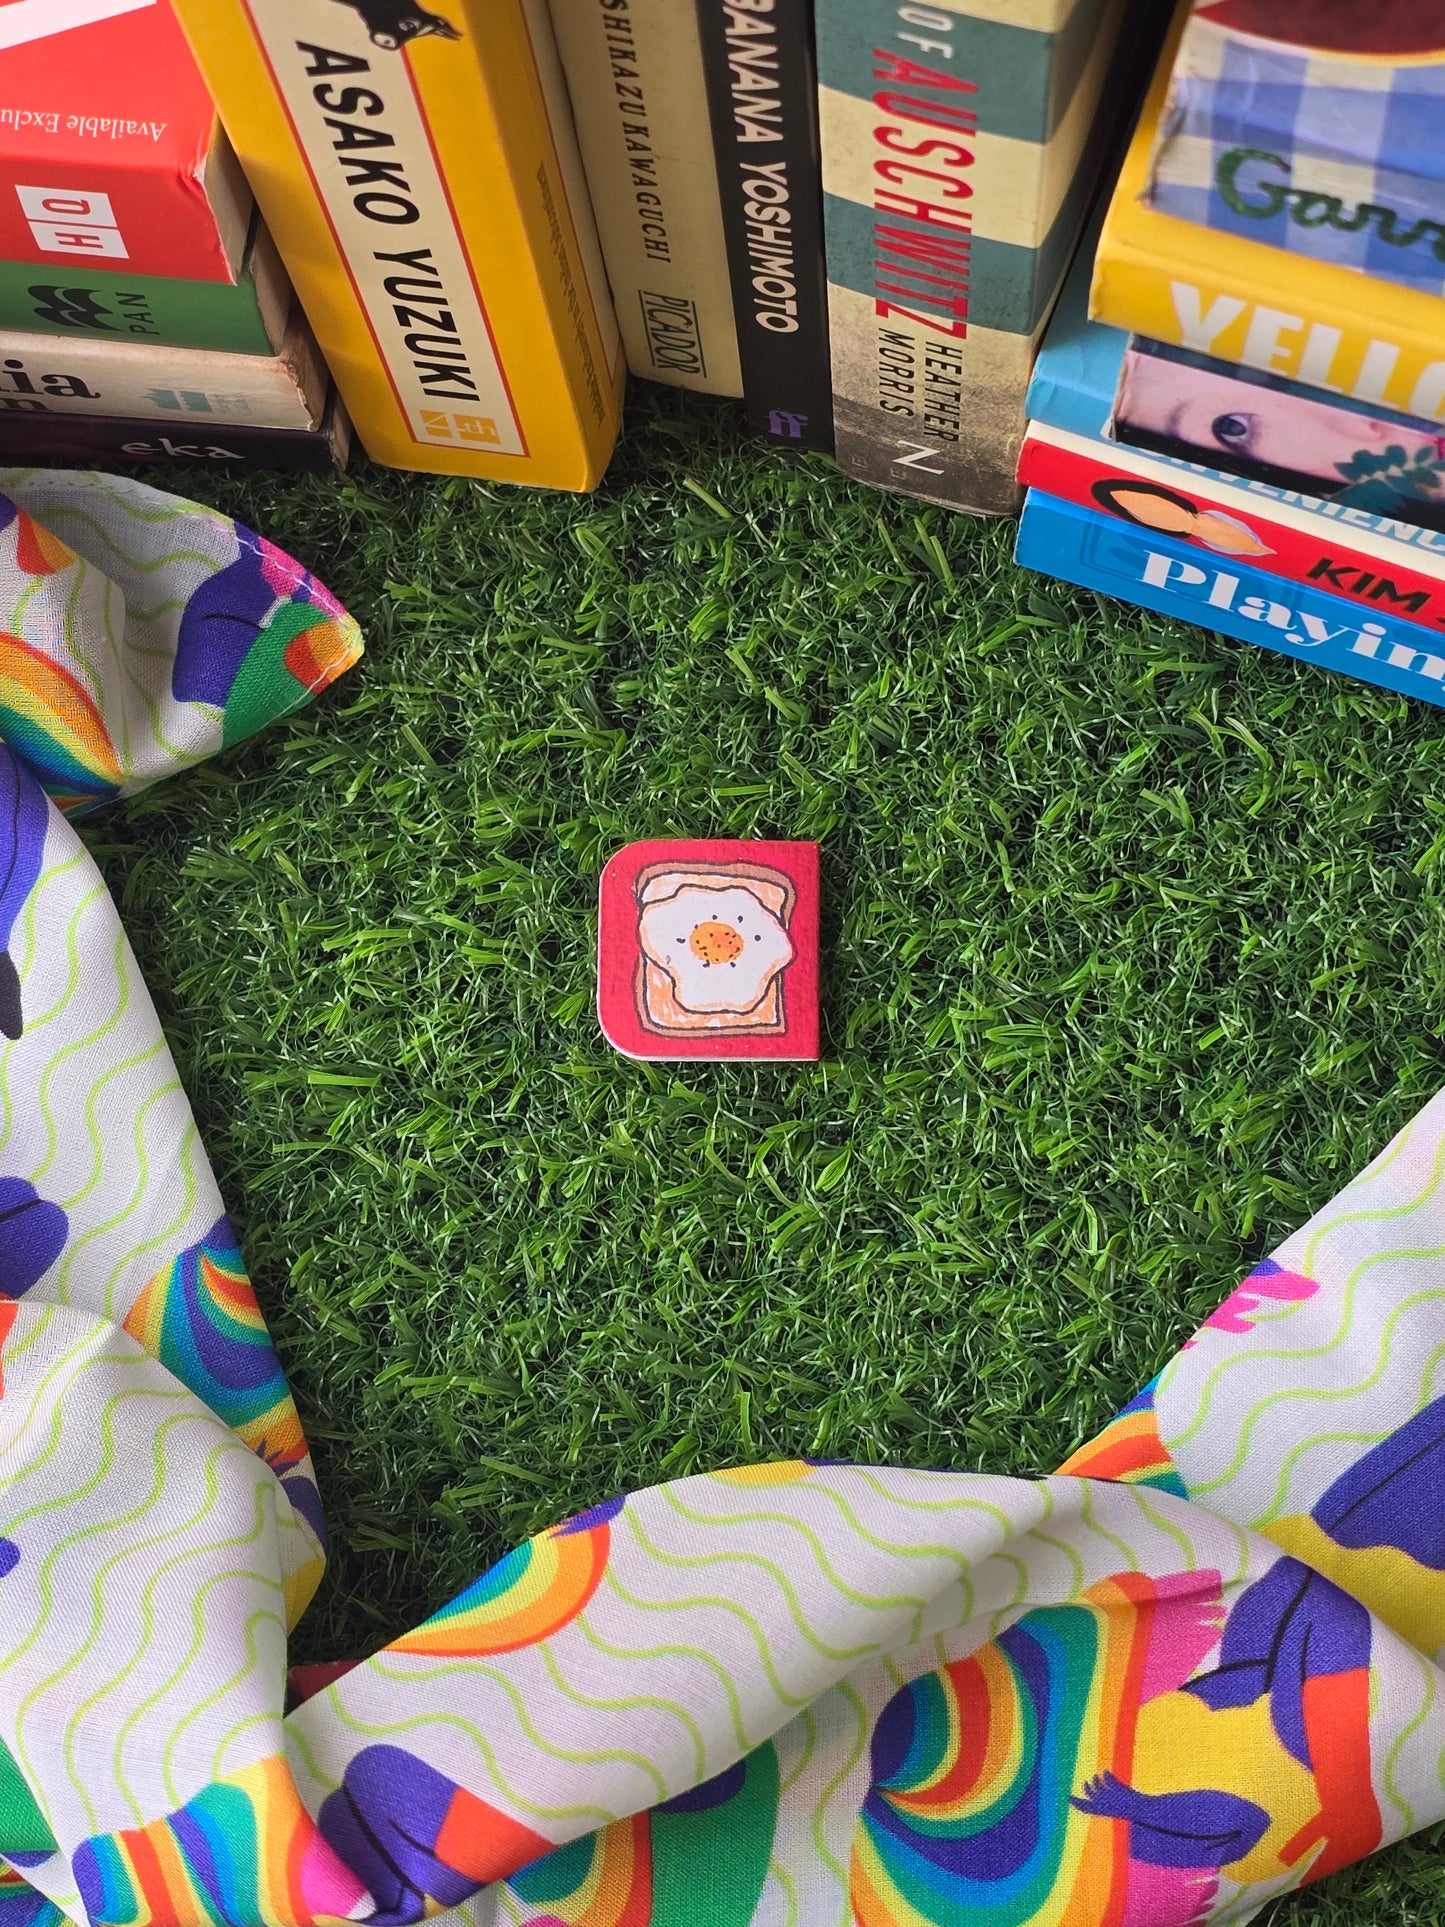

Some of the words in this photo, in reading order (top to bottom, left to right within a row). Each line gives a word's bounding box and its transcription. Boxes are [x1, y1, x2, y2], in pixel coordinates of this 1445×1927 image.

[897, 6, 954, 59] OF
[0, 109, 61, 134] Exclu
[66, 115, 168, 142] Available
[295, 40, 420, 225] ASAKO
[373, 248, 480, 402] YUZUKI
[622, 121, 672, 263] KAWAGUCHI
[872, 48, 980, 340] AUSCHWITZ
[739, 162, 799, 334] YOSHIMOTO
[115, 291, 160, 336] PAN
[643, 290, 701, 375] PICADOR
[0, 359, 101, 399] ia
[878, 327, 916, 418] MORRIS
[924, 341, 963, 442] HEATHER
[120, 437, 246, 460] eka
[1136, 549, 1445, 691] Playin
[1307, 557, 1432, 614] KIM
